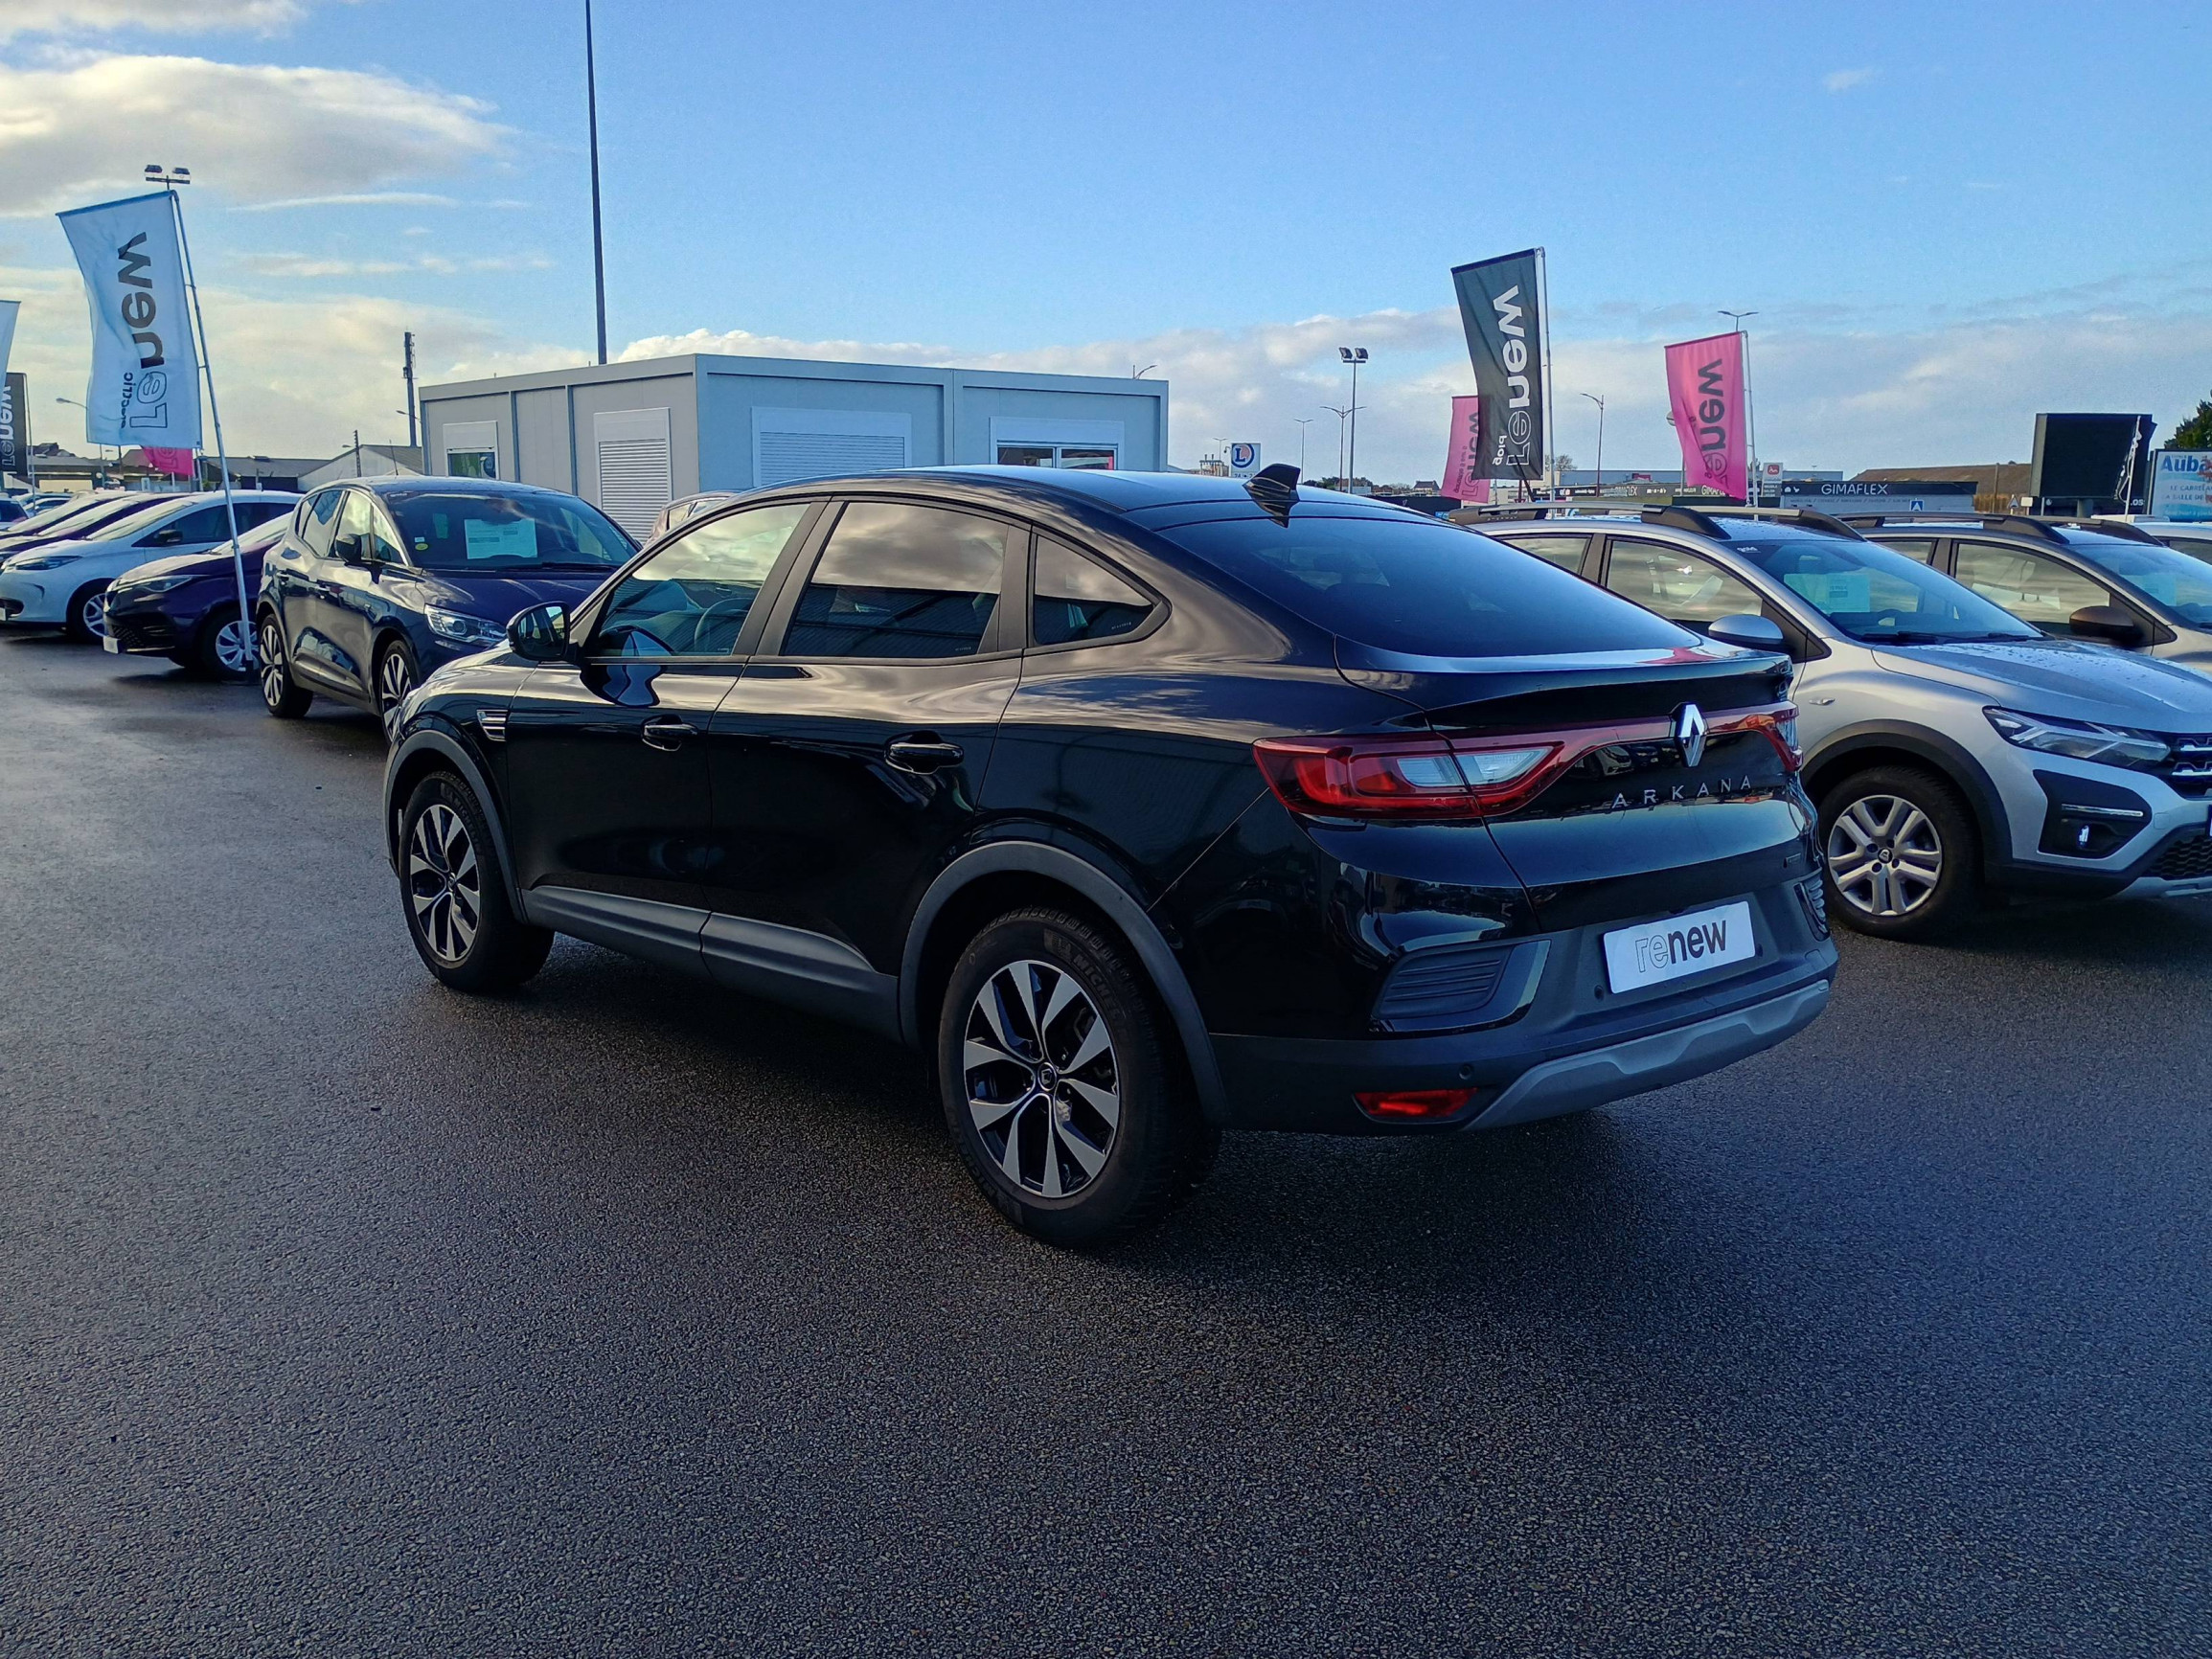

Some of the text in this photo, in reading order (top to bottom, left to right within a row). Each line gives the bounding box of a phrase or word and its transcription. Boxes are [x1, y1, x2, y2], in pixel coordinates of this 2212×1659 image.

[1821, 484, 1888, 495] GIMAFLEX
[1611, 775, 1751, 809] ARKANA
[1634, 920, 1727, 973] renew
